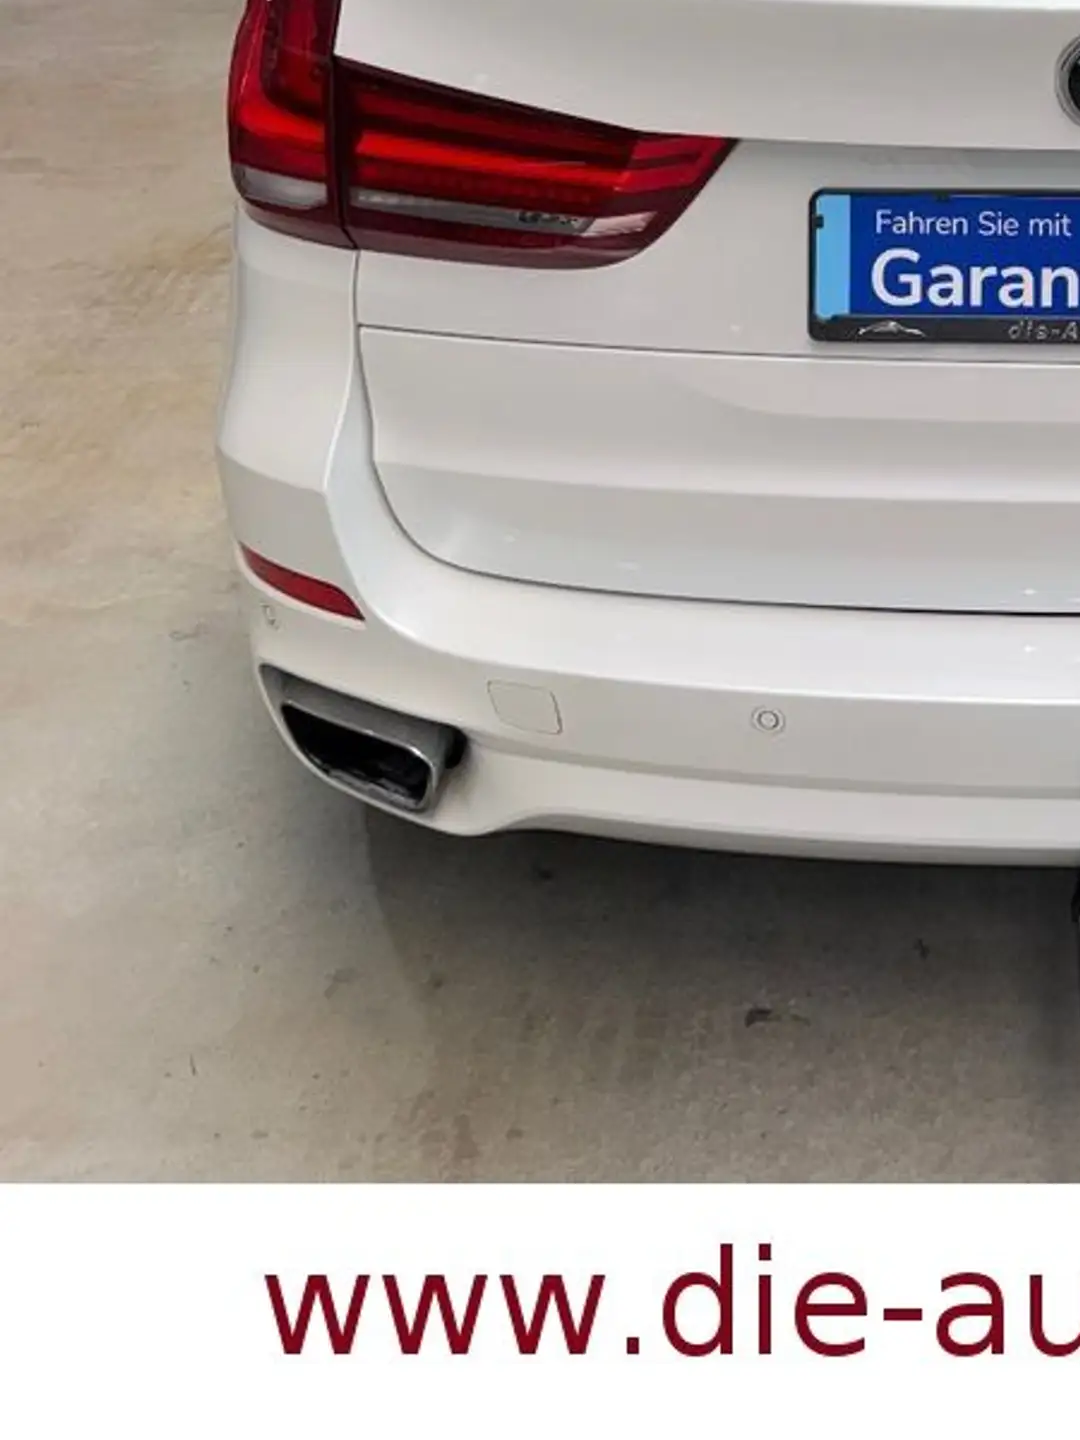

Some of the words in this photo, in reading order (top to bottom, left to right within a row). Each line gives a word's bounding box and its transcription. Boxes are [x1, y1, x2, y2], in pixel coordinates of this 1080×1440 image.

[875, 209, 968, 236] Fahren
[978, 211, 1018, 236] Sie
[1029, 213, 1072, 236] mit
